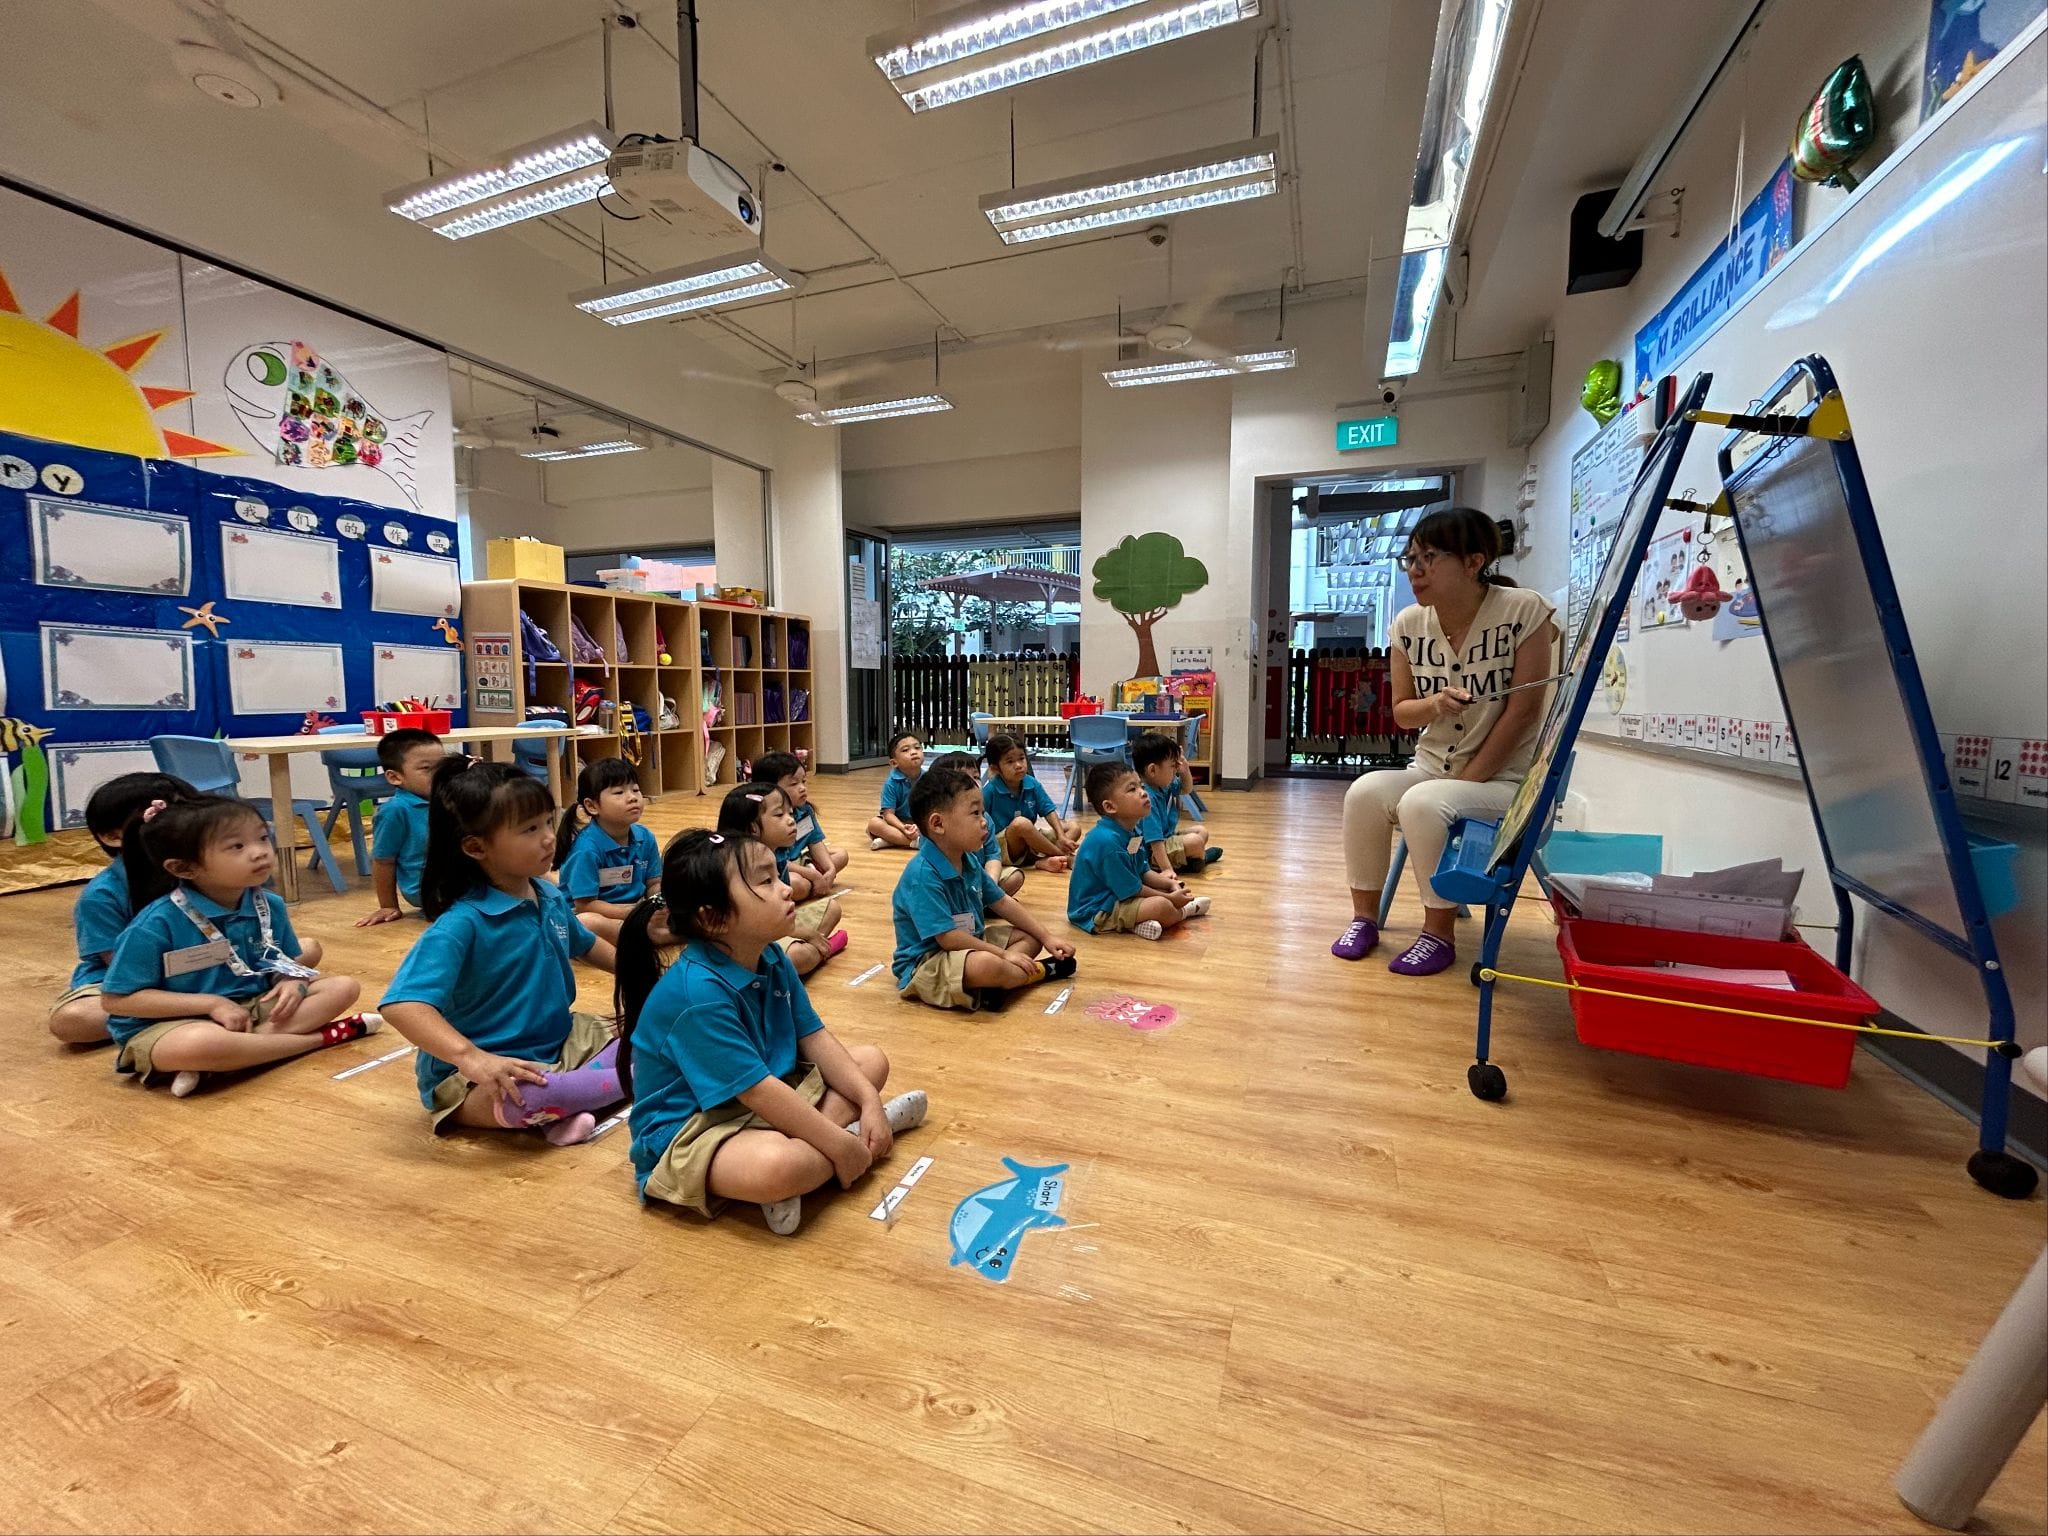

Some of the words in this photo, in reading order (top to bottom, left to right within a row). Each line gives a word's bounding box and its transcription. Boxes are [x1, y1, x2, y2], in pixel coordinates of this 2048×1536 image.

[1656, 327, 1669, 364] K1
[1671, 232, 1756, 349] BRILLIANCE
[1348, 423, 1385, 445] EXIT
[1660, 722, 1665, 734] 2
[1678, 724, 1682, 736] 3
[1721, 727, 1726, 740] 5
[1745, 727, 1751, 745] 6
[1775, 735, 1781, 749] 7
[1994, 759, 2011, 780] 12
[1039, 1180, 1058, 1207] Shark
